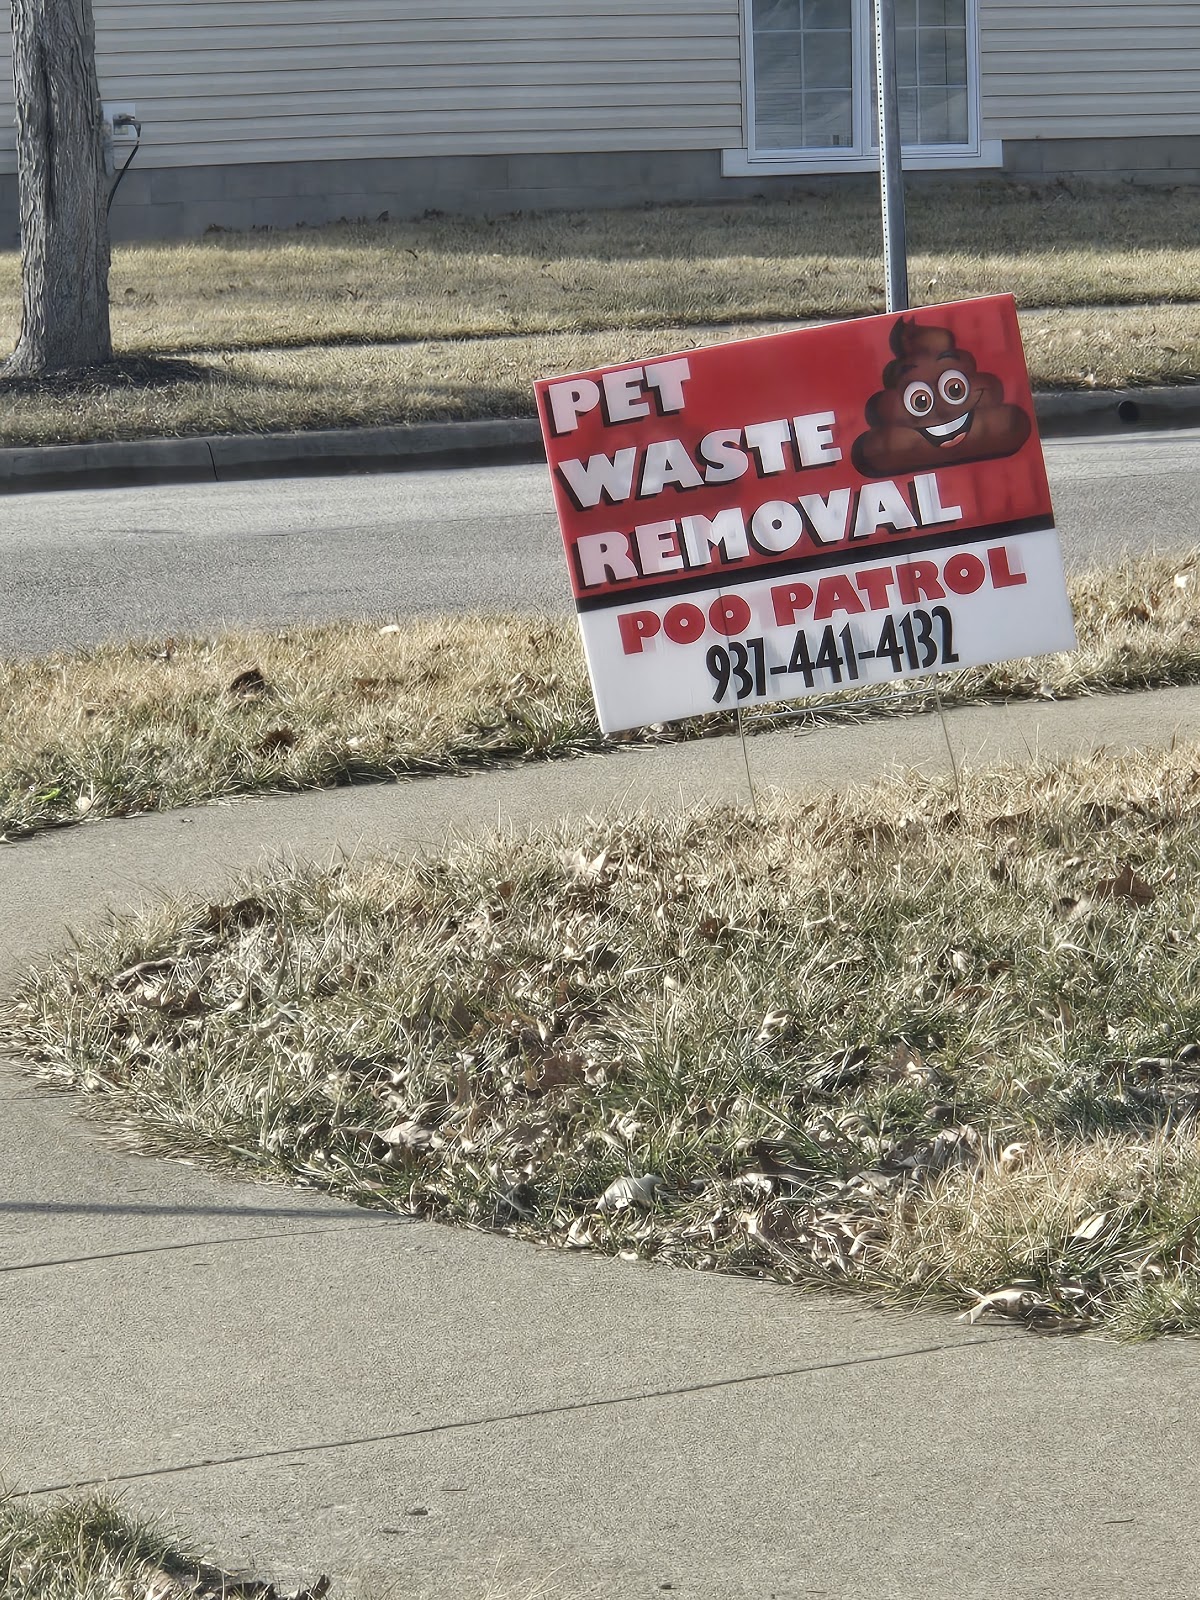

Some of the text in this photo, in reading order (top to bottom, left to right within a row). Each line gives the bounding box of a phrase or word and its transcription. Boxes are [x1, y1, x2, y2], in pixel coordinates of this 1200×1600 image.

[547, 357, 691, 436] PET
[557, 410, 842, 509] WASTE
[576, 473, 963, 588] REMOVAL
[617, 545, 1028, 656] POO PATROL
[705, 604, 960, 704] 937-441-4132
